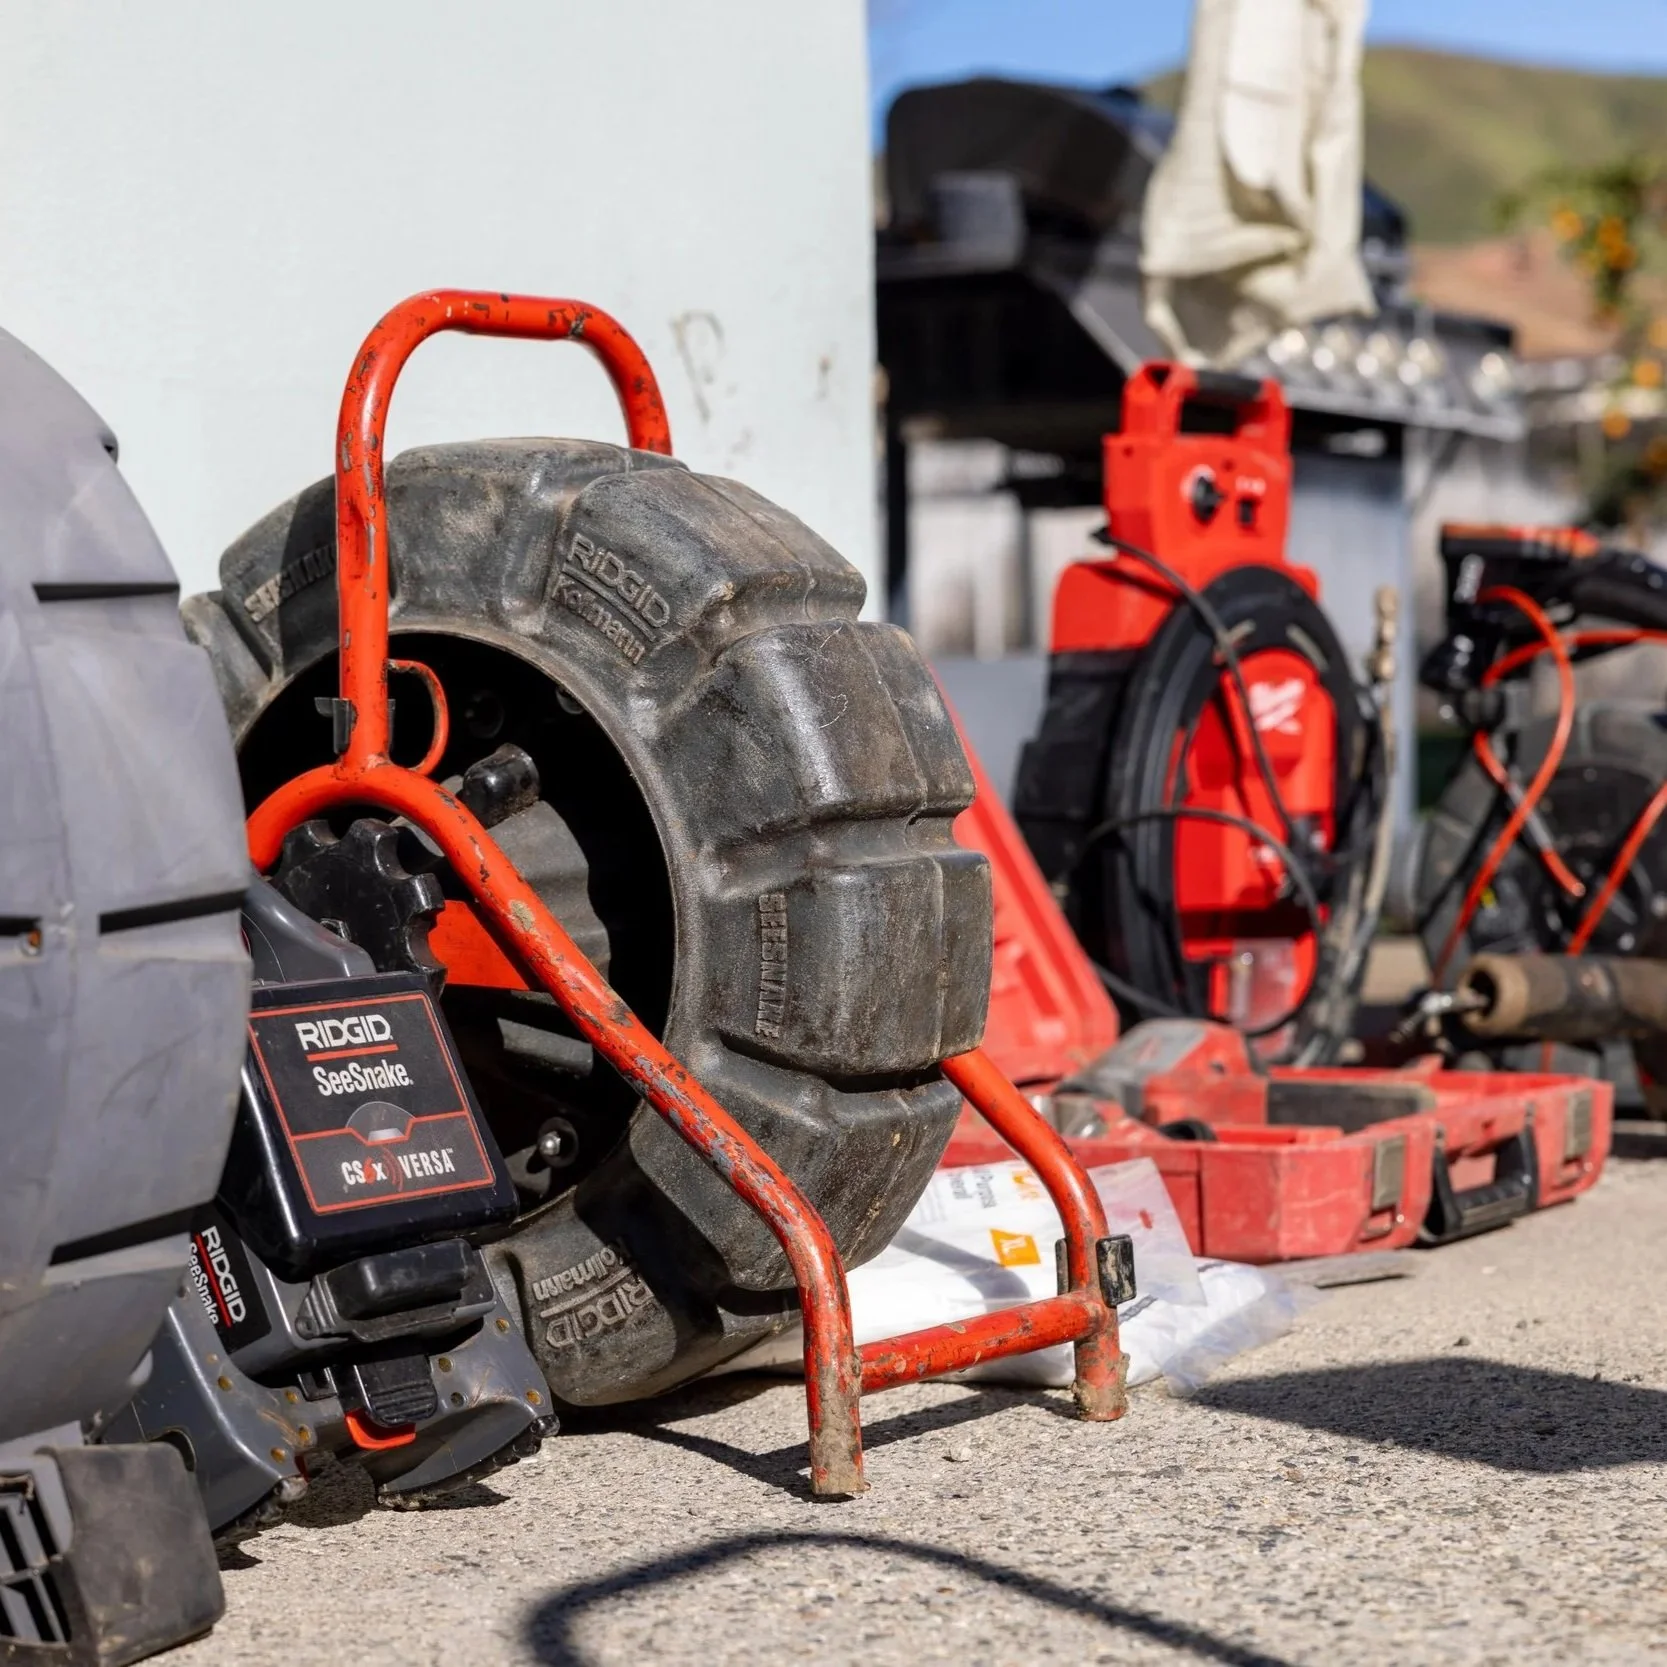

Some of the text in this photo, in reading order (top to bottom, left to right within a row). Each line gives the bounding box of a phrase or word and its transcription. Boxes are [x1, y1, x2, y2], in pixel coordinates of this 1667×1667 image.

[243, 544, 337, 623] SEESNAK
[567, 532, 670, 628] RIDGID
[754, 893, 788, 1038] SEESNAKE
[295, 1014, 392, 1050] RIDGID
[313, 1059, 411, 1096] SeeSnake
[201, 1226, 246, 1323] RIDGID
[546, 1279, 655, 1349] RIDGID
